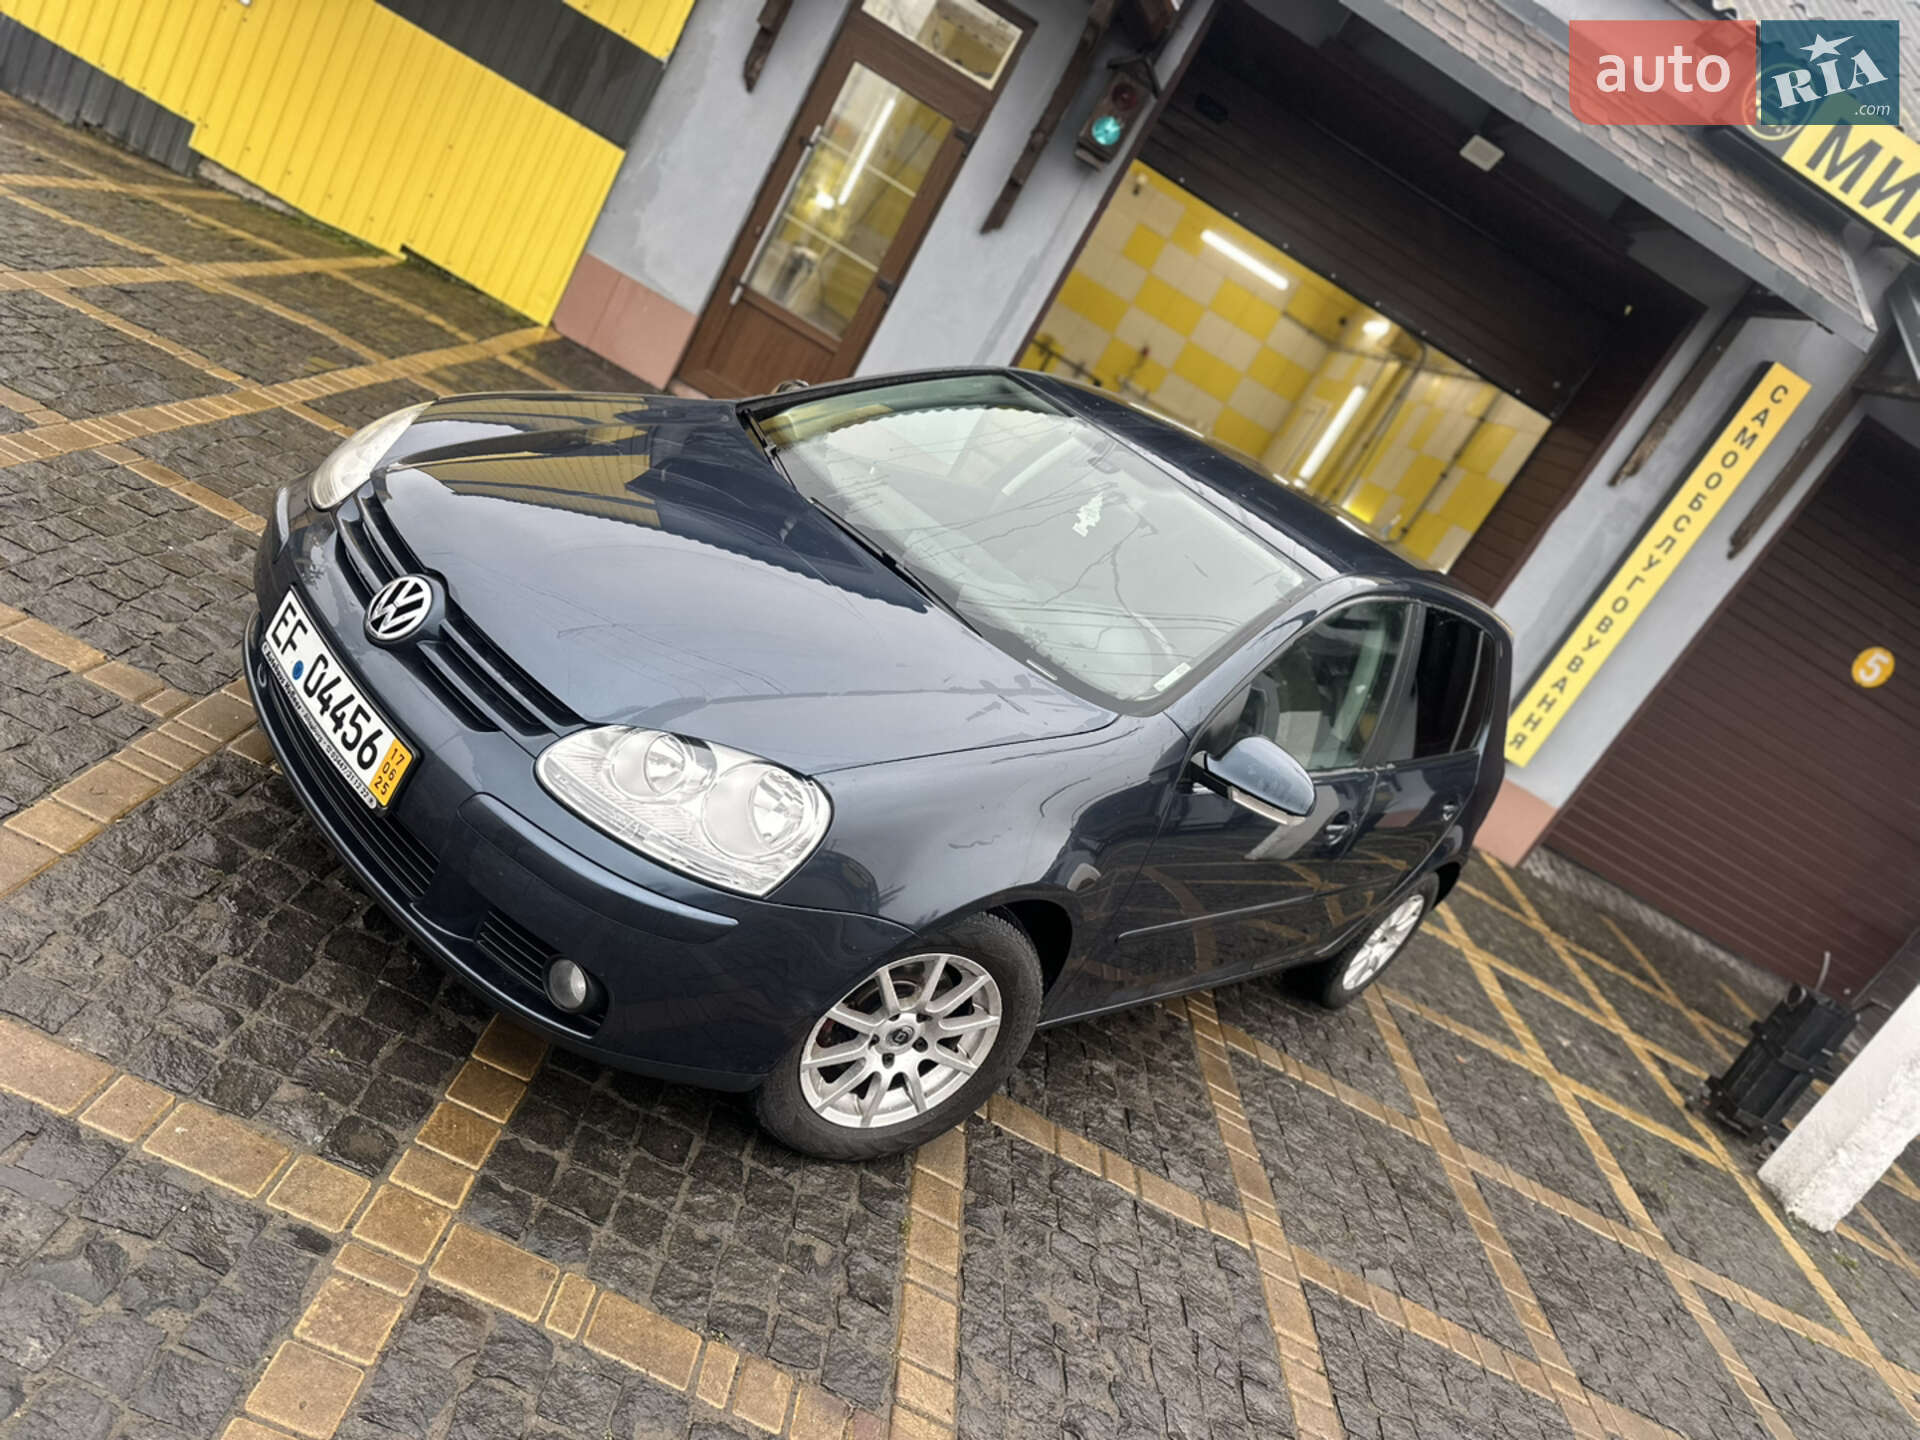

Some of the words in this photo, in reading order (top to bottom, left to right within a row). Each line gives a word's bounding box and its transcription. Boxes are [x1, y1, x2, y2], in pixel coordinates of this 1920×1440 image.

[1806, 118, 1920, 240] МИ
[1508, 384, 1789, 751] САМООБСЛУГОВУВАННЯ
[1859, 653, 1889, 682] 5
[271, 602, 308, 654] EF
[303, 654, 383, 770] 04456
[390, 747, 405, 765] 17
[374, 776, 391, 796] 25
[382, 763, 397, 781] 06
